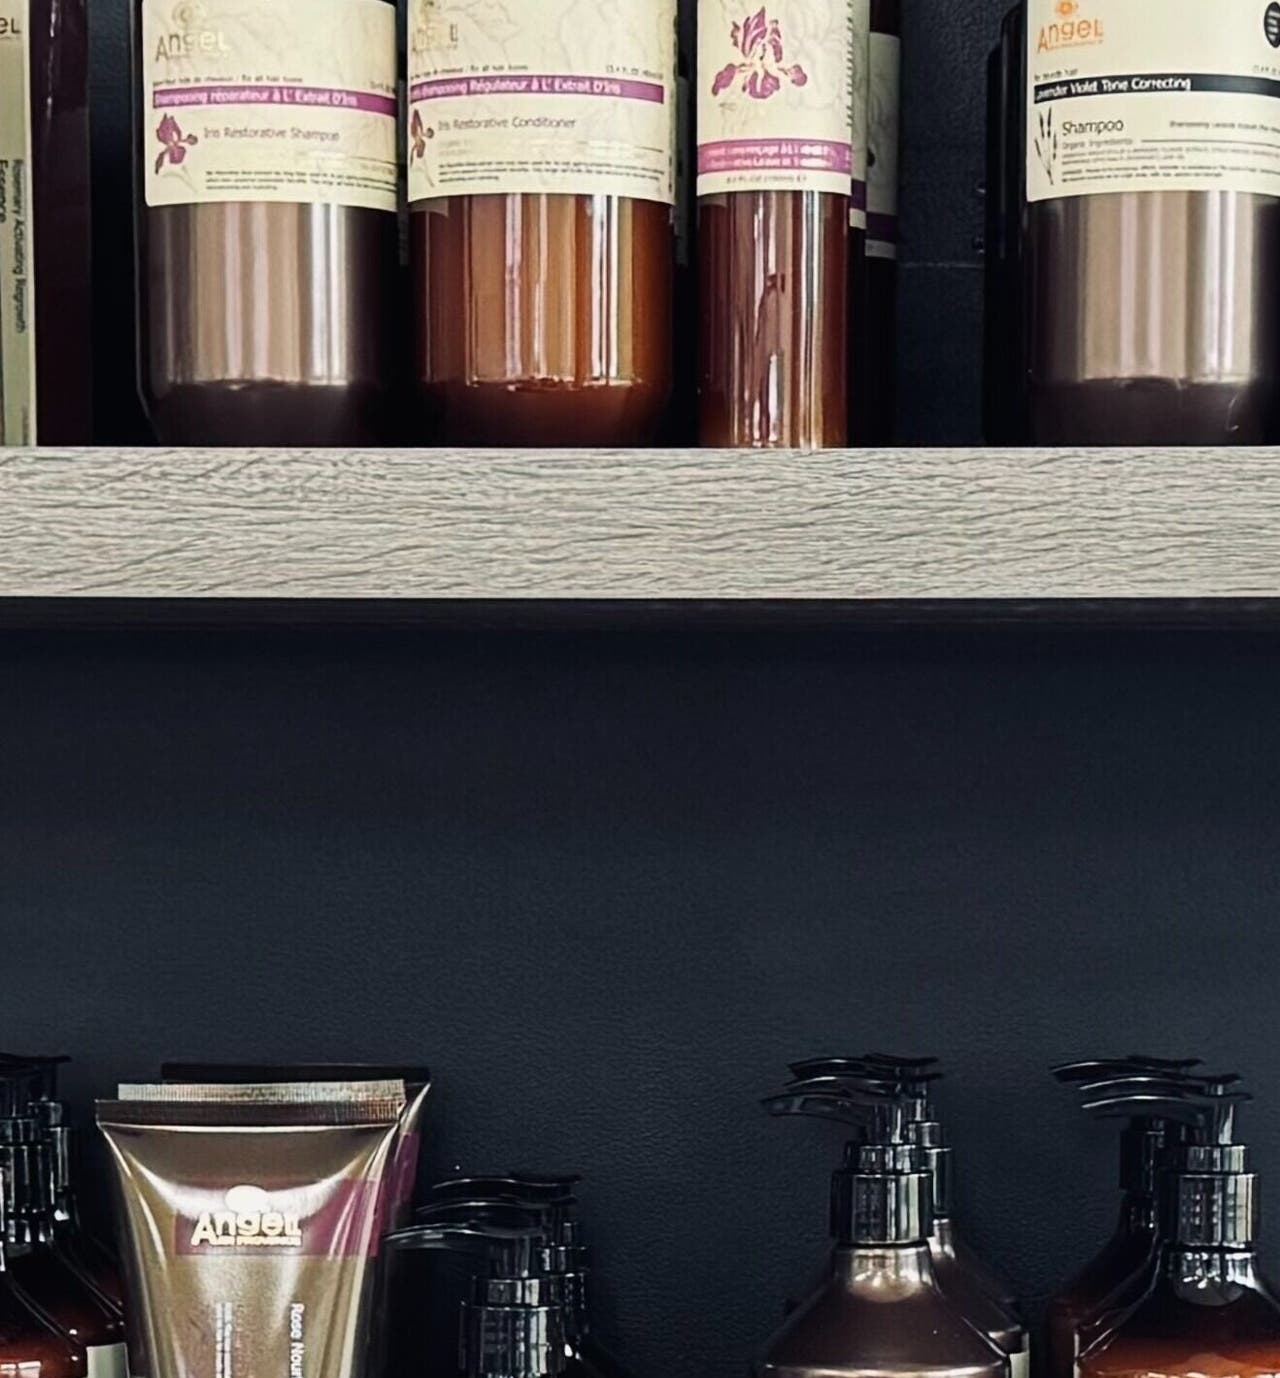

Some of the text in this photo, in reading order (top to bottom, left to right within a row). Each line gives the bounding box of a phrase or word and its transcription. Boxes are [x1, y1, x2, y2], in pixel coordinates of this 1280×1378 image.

[1101, 79, 1129, 92] Tone
[1131, 77, 1191, 92] Correcting
[454, 118, 509, 130] Restorative
[512, 116, 576, 129] Conditioner
[1062, 119, 1124, 136] Shampoo
[224, 127, 287, 139] Restorative
[290, 1303, 305, 1340] Rose
